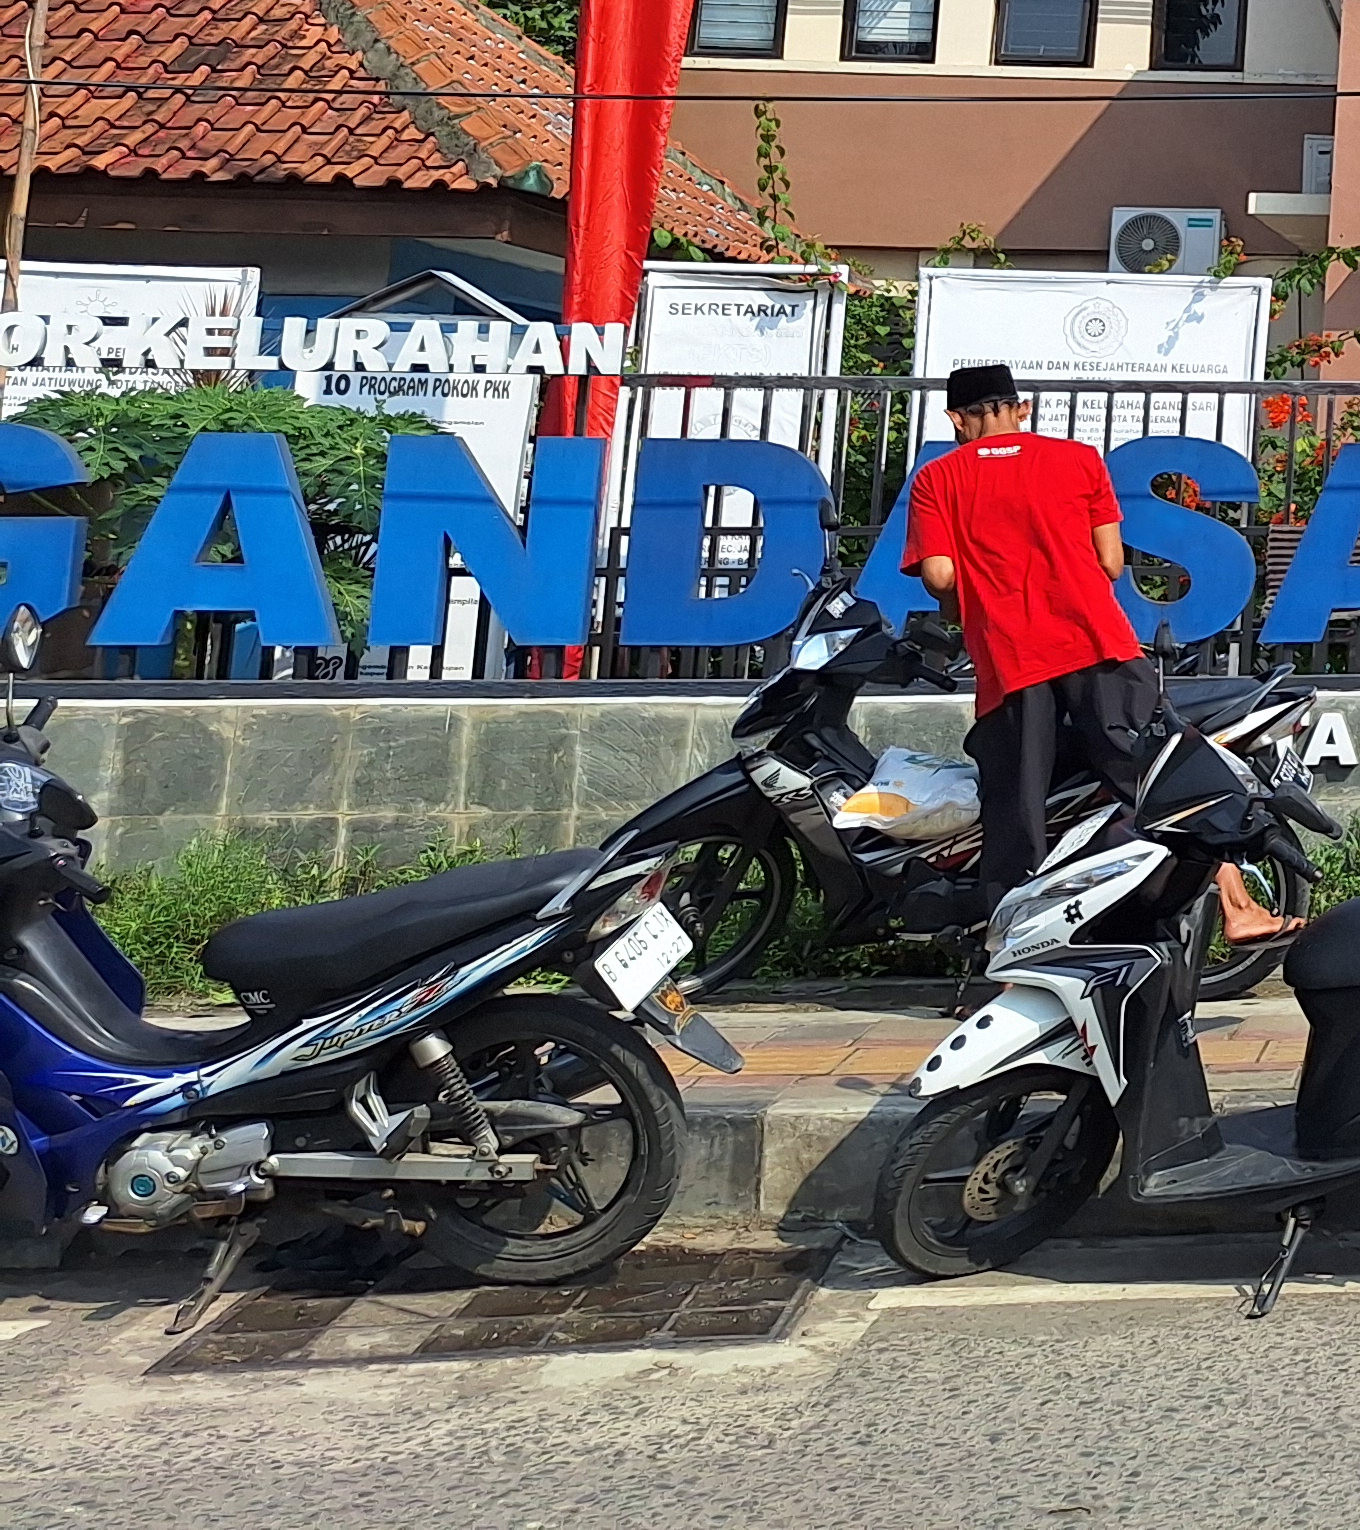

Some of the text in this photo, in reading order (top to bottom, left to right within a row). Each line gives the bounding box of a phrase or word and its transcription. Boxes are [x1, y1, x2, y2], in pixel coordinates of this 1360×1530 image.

[668, 303, 800, 318] SEKRETARIAT
[122, 316, 625, 376] KELURAHAN
[1047, 360, 1070, 371] DAN
[1074, 360, 1167, 373] KESEJAHTERAAN
[1171, 362, 1228, 374] KELUARGA
[32, 377, 102, 388] JATIUWUNG
[323, 374, 511, 400] 10 PROGRAM POKOK PKK
[1082, 399, 1145, 411] KELRAHA
[1153, 401, 1216, 412] GANDSARI
[1048, 414, 1101, 423] JATIWUNG
[1131, 415, 1181, 424] TAGERAN
[602, 908, 674, 983] B 6406 CJX
[1011, 937, 1062, 958] HONDA
[240, 989, 271, 1005] CMC
